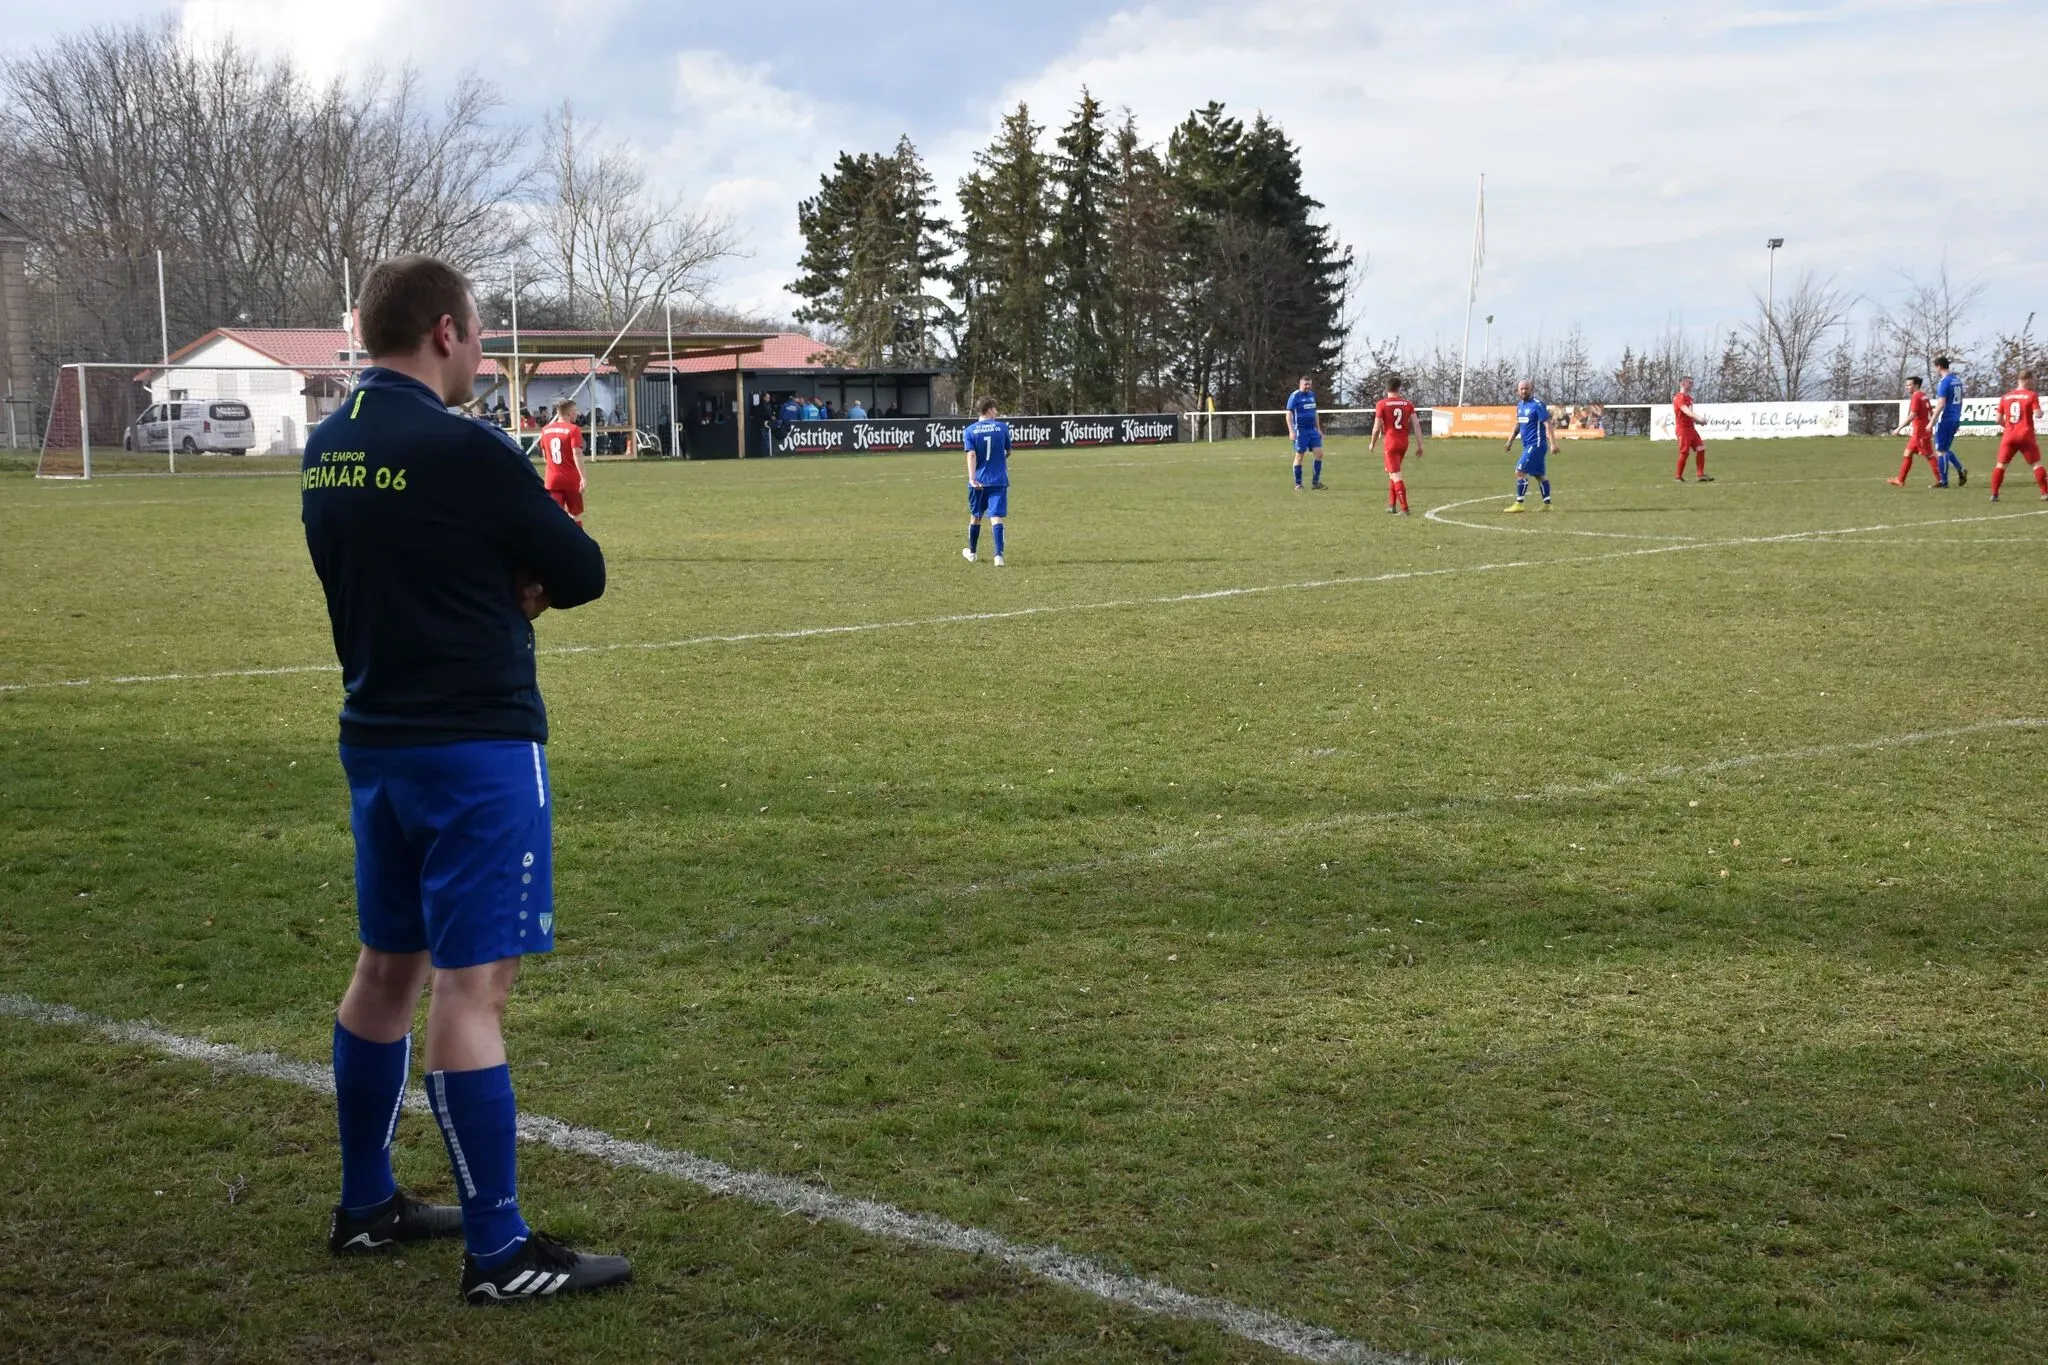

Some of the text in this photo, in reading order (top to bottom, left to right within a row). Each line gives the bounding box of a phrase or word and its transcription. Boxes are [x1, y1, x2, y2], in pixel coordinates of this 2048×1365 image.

[1393, 408, 1403, 429] 2
[1785, 411, 1819, 429] Erfurt
[2009, 401, 2021, 424] 9
[852, 423, 915, 450] Köstritzer
[1006, 421, 1051, 446] östritzer
[1060, 420, 1114, 444] Köstritzer
[1121, 418, 1174, 443] Köstritzer
[320, 451, 366, 462] FC EMPOR
[550, 437, 562, 465] 8
[375, 466, 407, 491] 06
